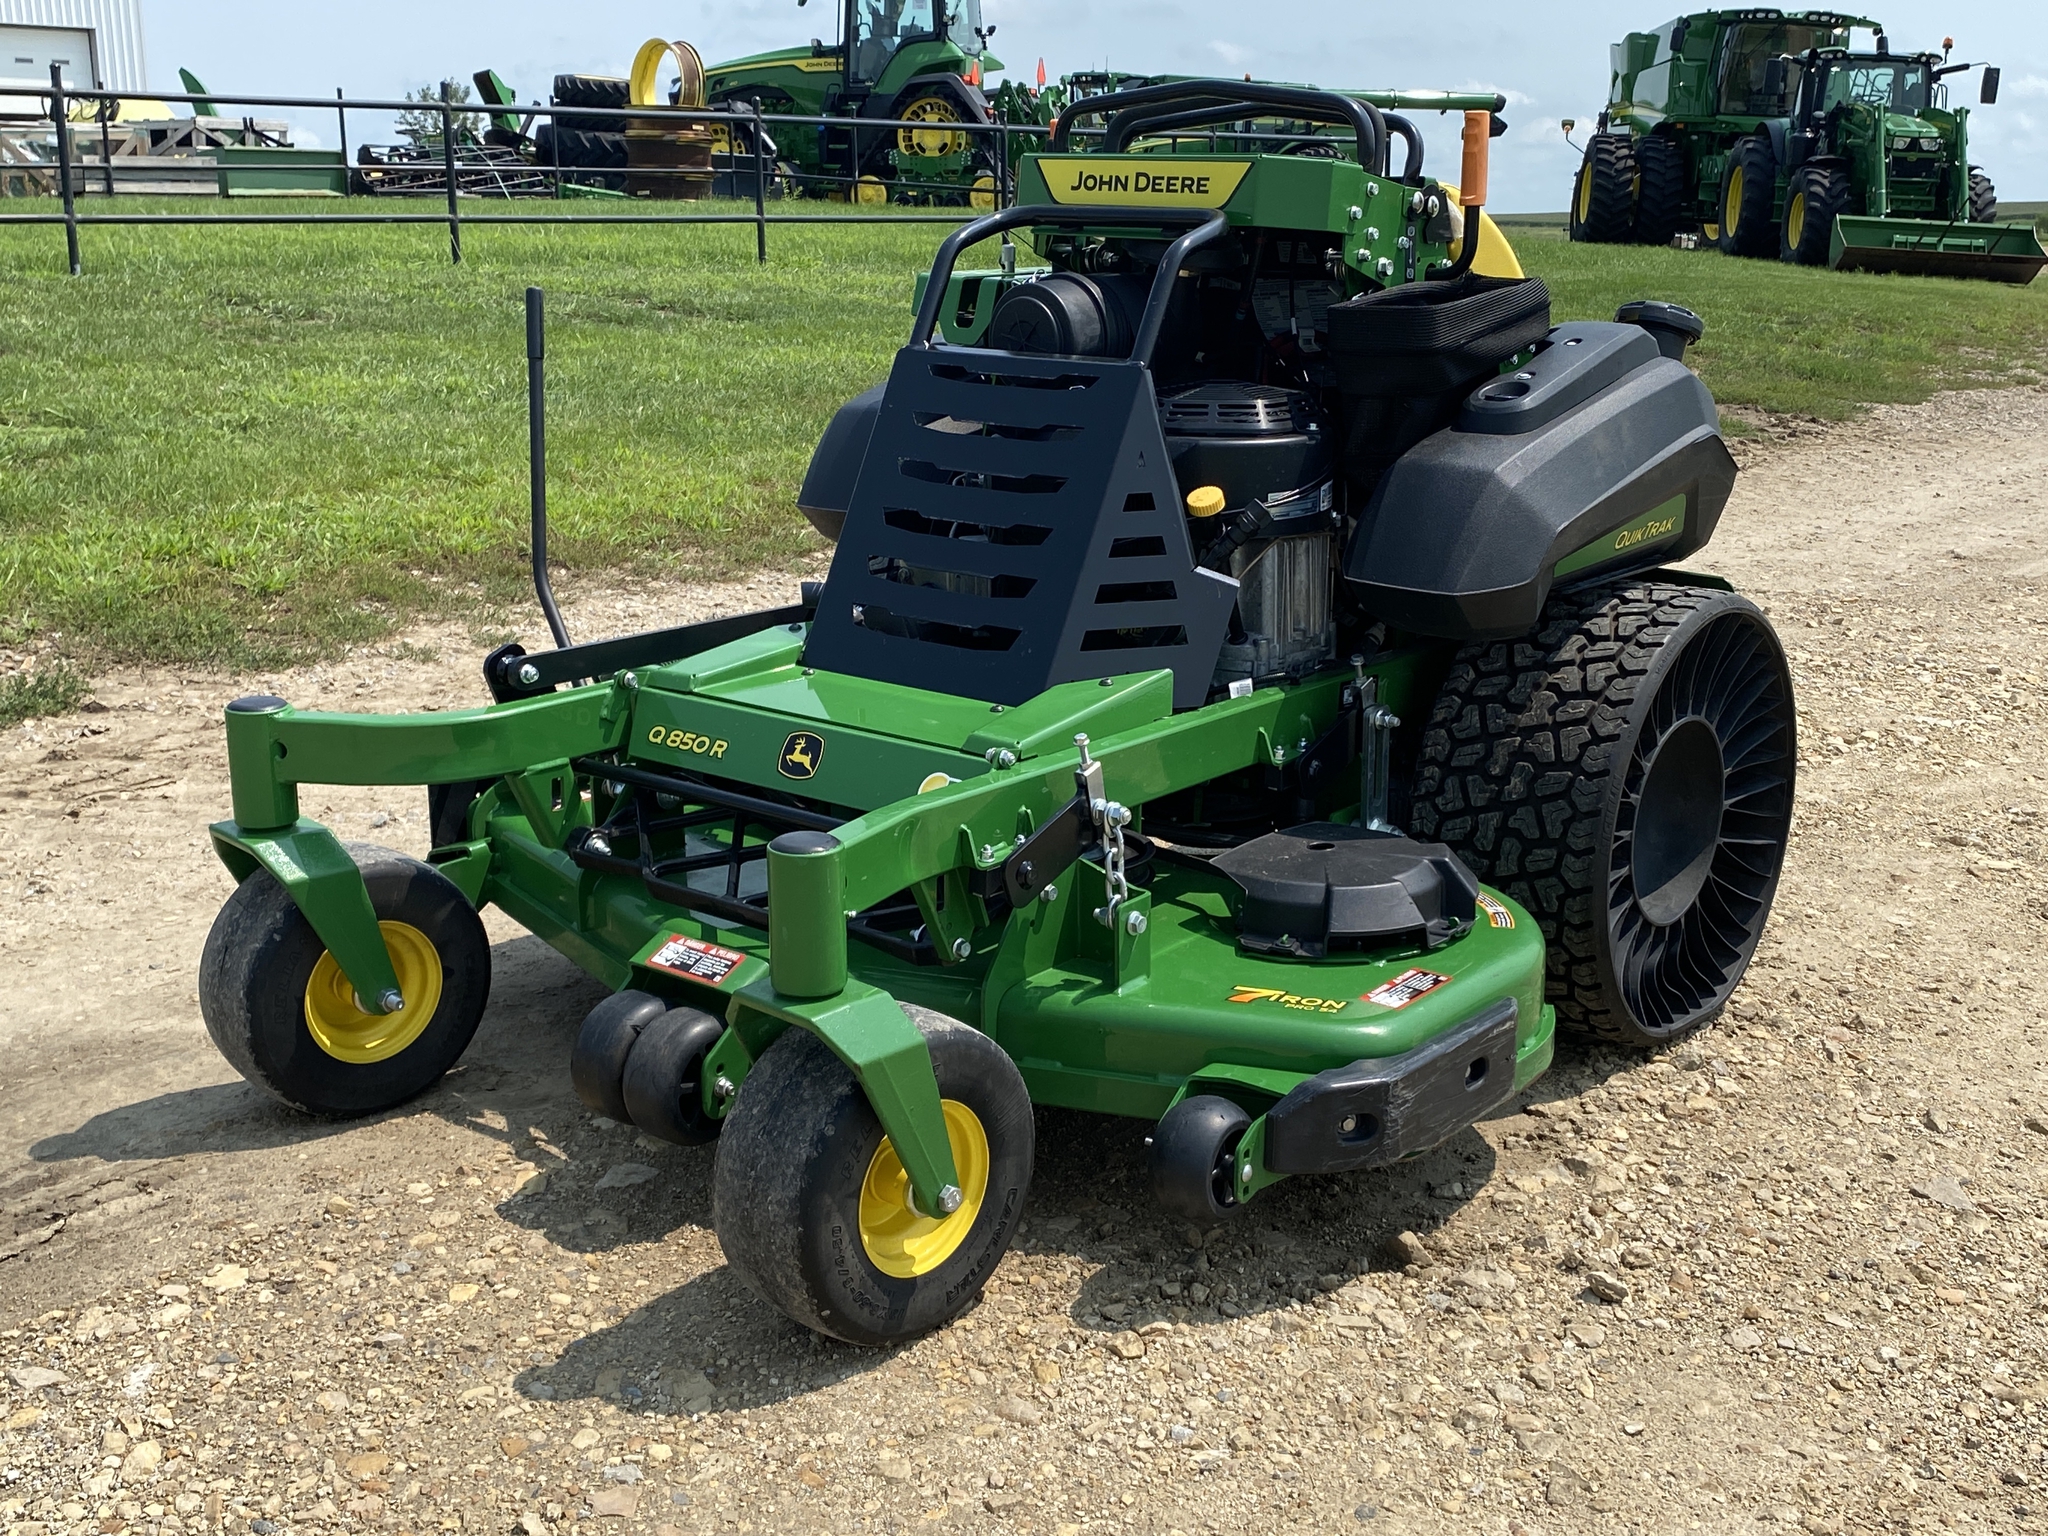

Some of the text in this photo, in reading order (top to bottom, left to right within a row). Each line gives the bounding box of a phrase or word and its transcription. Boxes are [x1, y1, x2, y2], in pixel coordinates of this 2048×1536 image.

[1071, 171, 1210, 194] JOHN DEERE
[1284, 1003, 1315, 1011] PRO
